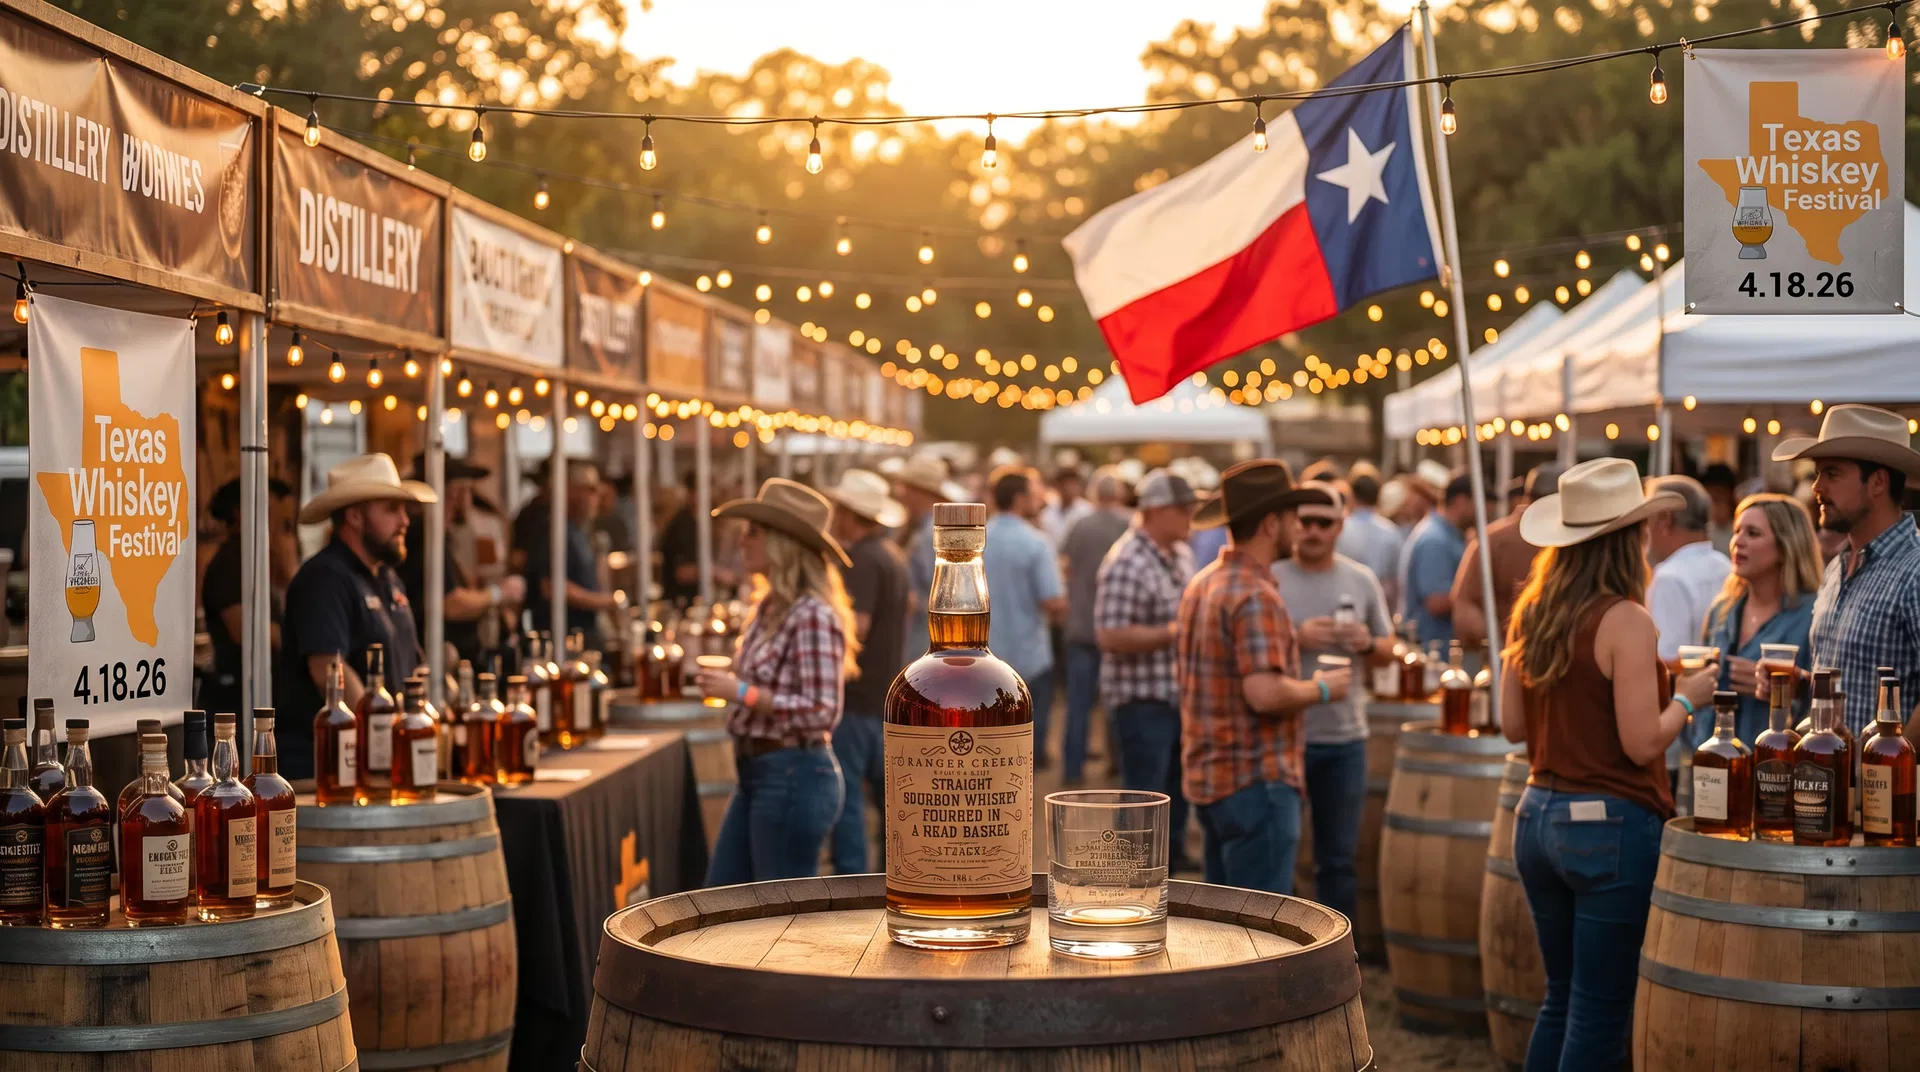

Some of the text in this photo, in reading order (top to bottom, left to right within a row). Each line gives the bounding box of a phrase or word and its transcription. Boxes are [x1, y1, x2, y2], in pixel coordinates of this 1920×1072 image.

[0, 86, 111, 184] DISTILLERY
[1762, 123, 1861, 152] Texas
[1735, 154, 1879, 192] Whiskey
[1784, 187, 1880, 210] Festival
[299, 186, 423, 295] DISTILLERY
[1738, 271, 1854, 298] 4.18.26
[94, 414, 166, 464] Texas
[68, 466, 181, 527] Whiskey
[109, 520, 181, 558] Festival
[73, 657, 167, 705] 4.18.26
[908, 757, 1014, 768] RANGER CREEK
[931, 777, 993, 791] STRAIGHT
[987, 808, 1001, 822] IN
